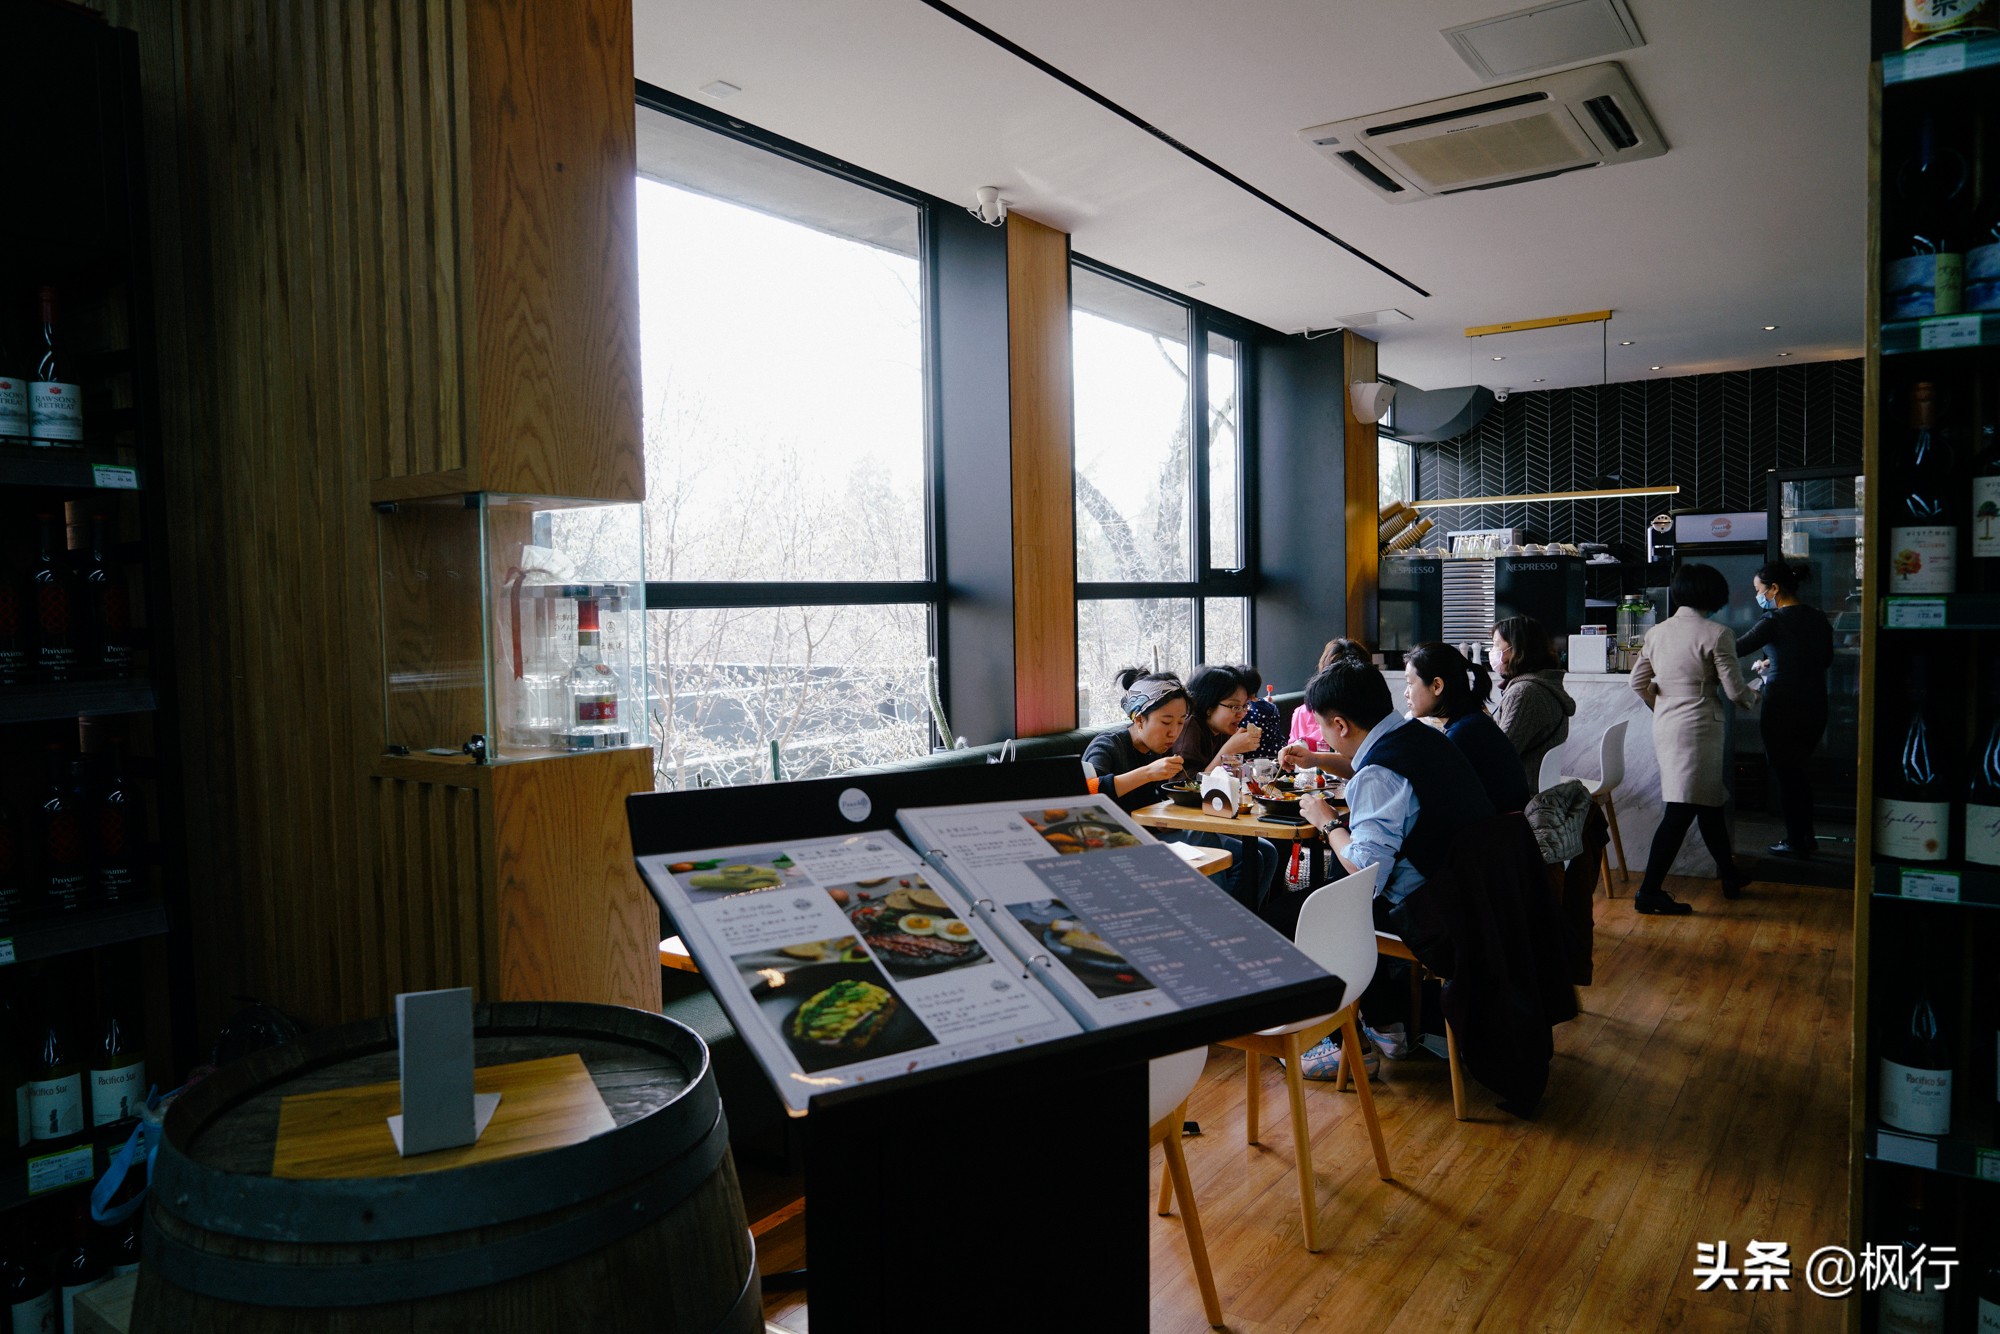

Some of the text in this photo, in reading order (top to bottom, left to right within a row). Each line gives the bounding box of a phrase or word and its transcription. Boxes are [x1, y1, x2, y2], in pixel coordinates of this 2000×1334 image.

[38, 402, 75, 410] RETREAT
[1387, 566, 1435, 574] NESPRESSO
[1505, 562, 1558, 572] NESPRESSO
[98, 1071, 137, 1086] Pacifico Sur
[1906, 1073, 1936, 1086] Pacifico
[55, 1084, 68, 1095] Sur
